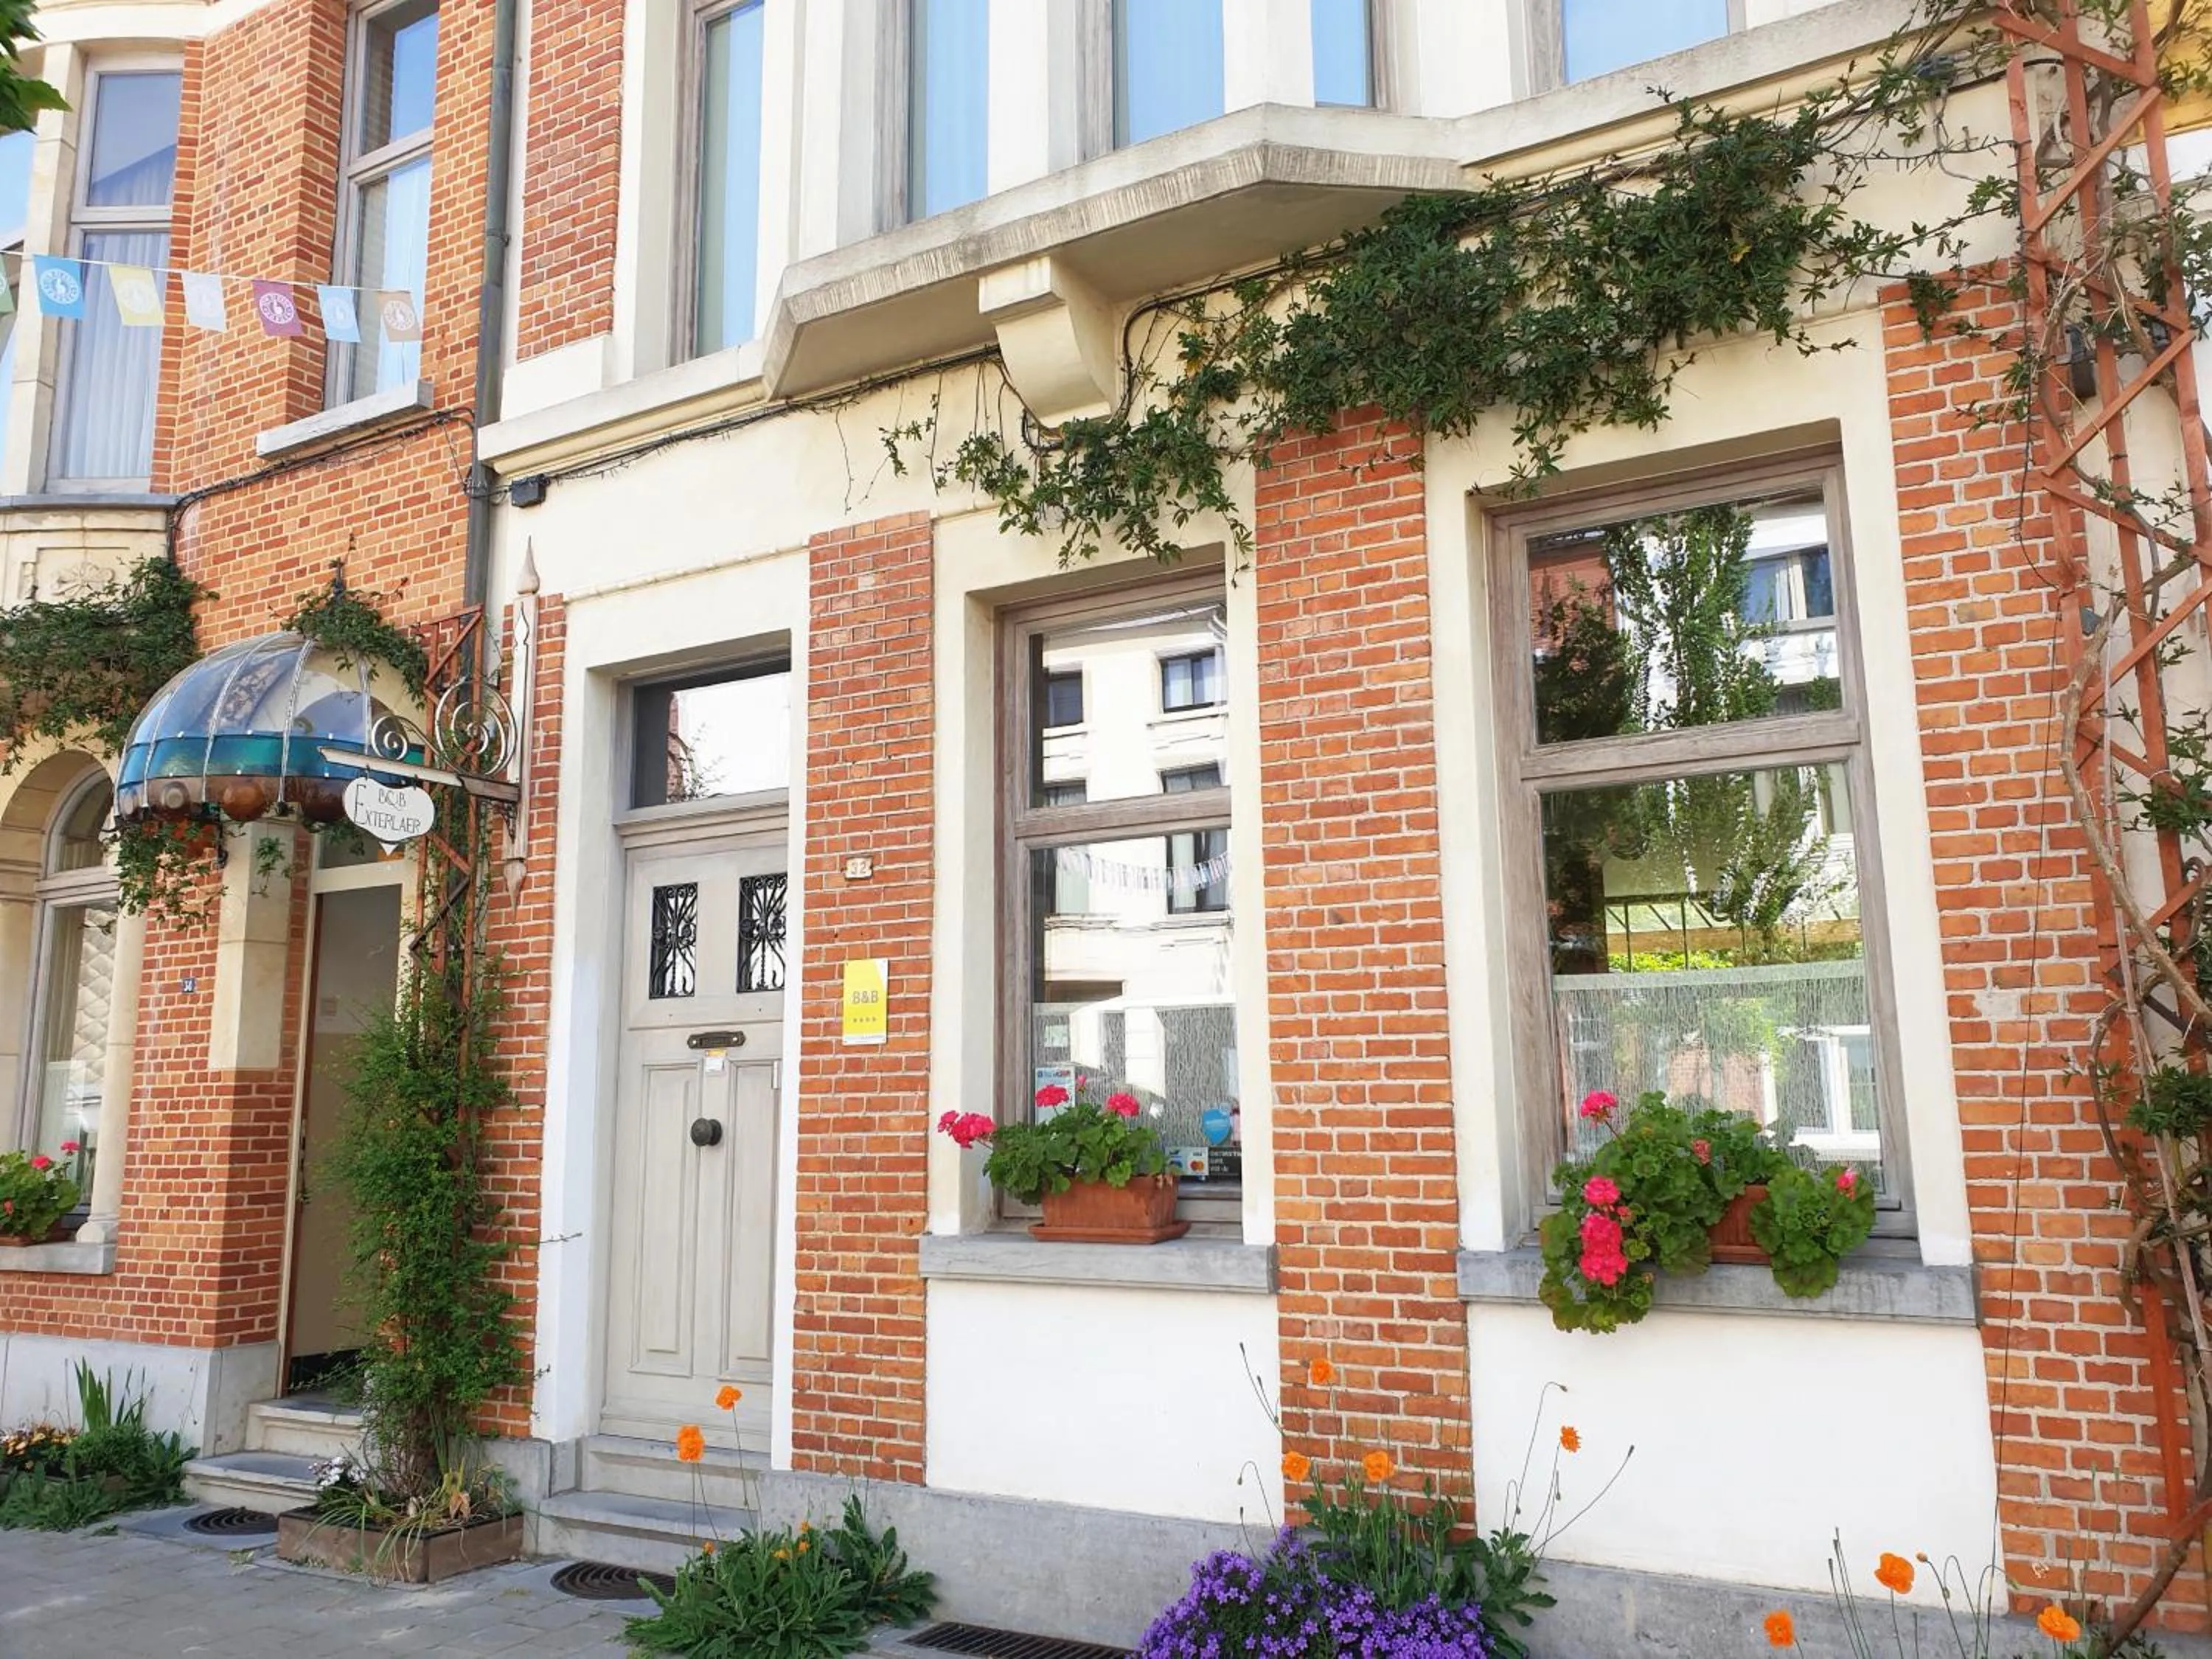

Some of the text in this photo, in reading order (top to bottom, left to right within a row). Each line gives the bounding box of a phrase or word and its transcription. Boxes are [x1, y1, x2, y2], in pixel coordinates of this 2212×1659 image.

[354, 784, 421, 833] EXTERLAER
[851, 860, 867, 875] 32
[852, 990, 879, 1004] B&B
